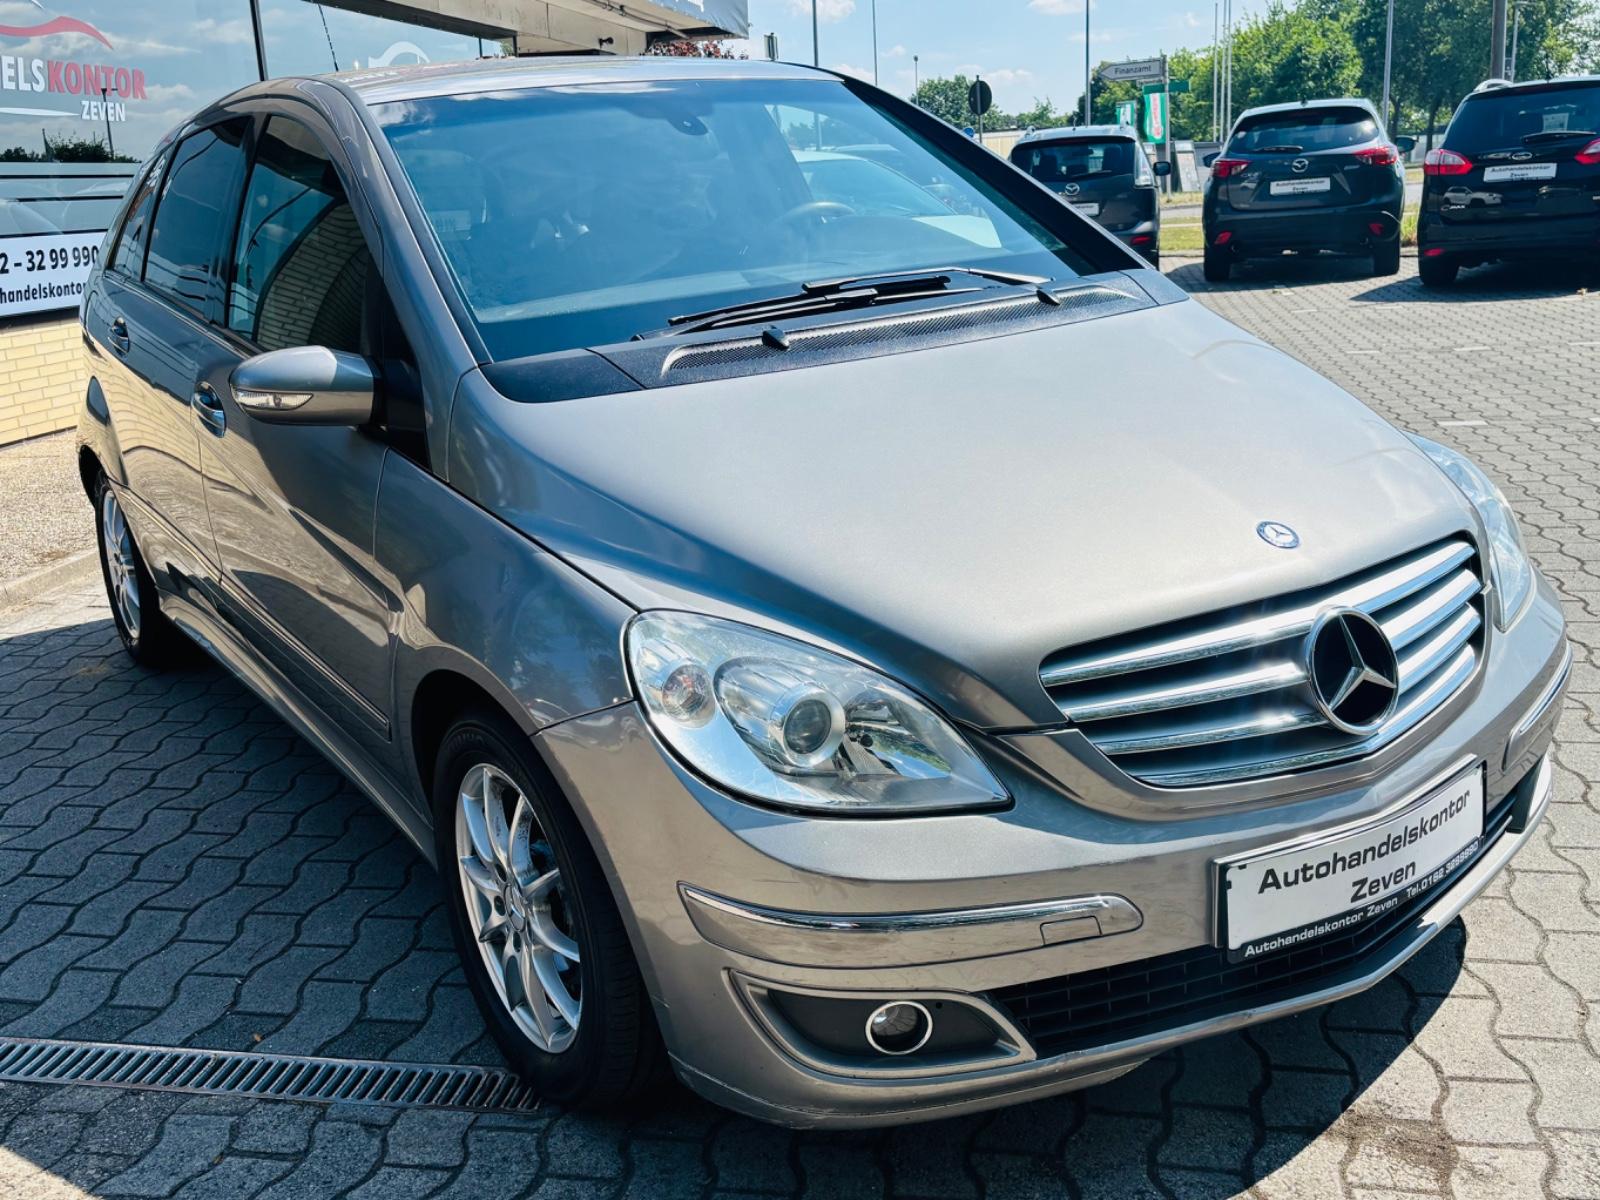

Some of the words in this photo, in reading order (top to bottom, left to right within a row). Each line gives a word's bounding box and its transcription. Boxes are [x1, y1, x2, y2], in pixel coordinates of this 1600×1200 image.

[1114, 66, 1152, 75] Finanzamt
[81, 100, 126, 121] ZEVEN
[25, 250, 46, 272] 32
[49, 247, 69, 269] 99
[1258, 790, 1471, 895] Autohandelskontor
[1350, 861, 1416, 903] Zeven
[1244, 911, 1364, 957] Autohandelskontor
[1367, 897, 1398, 917] Zeven
